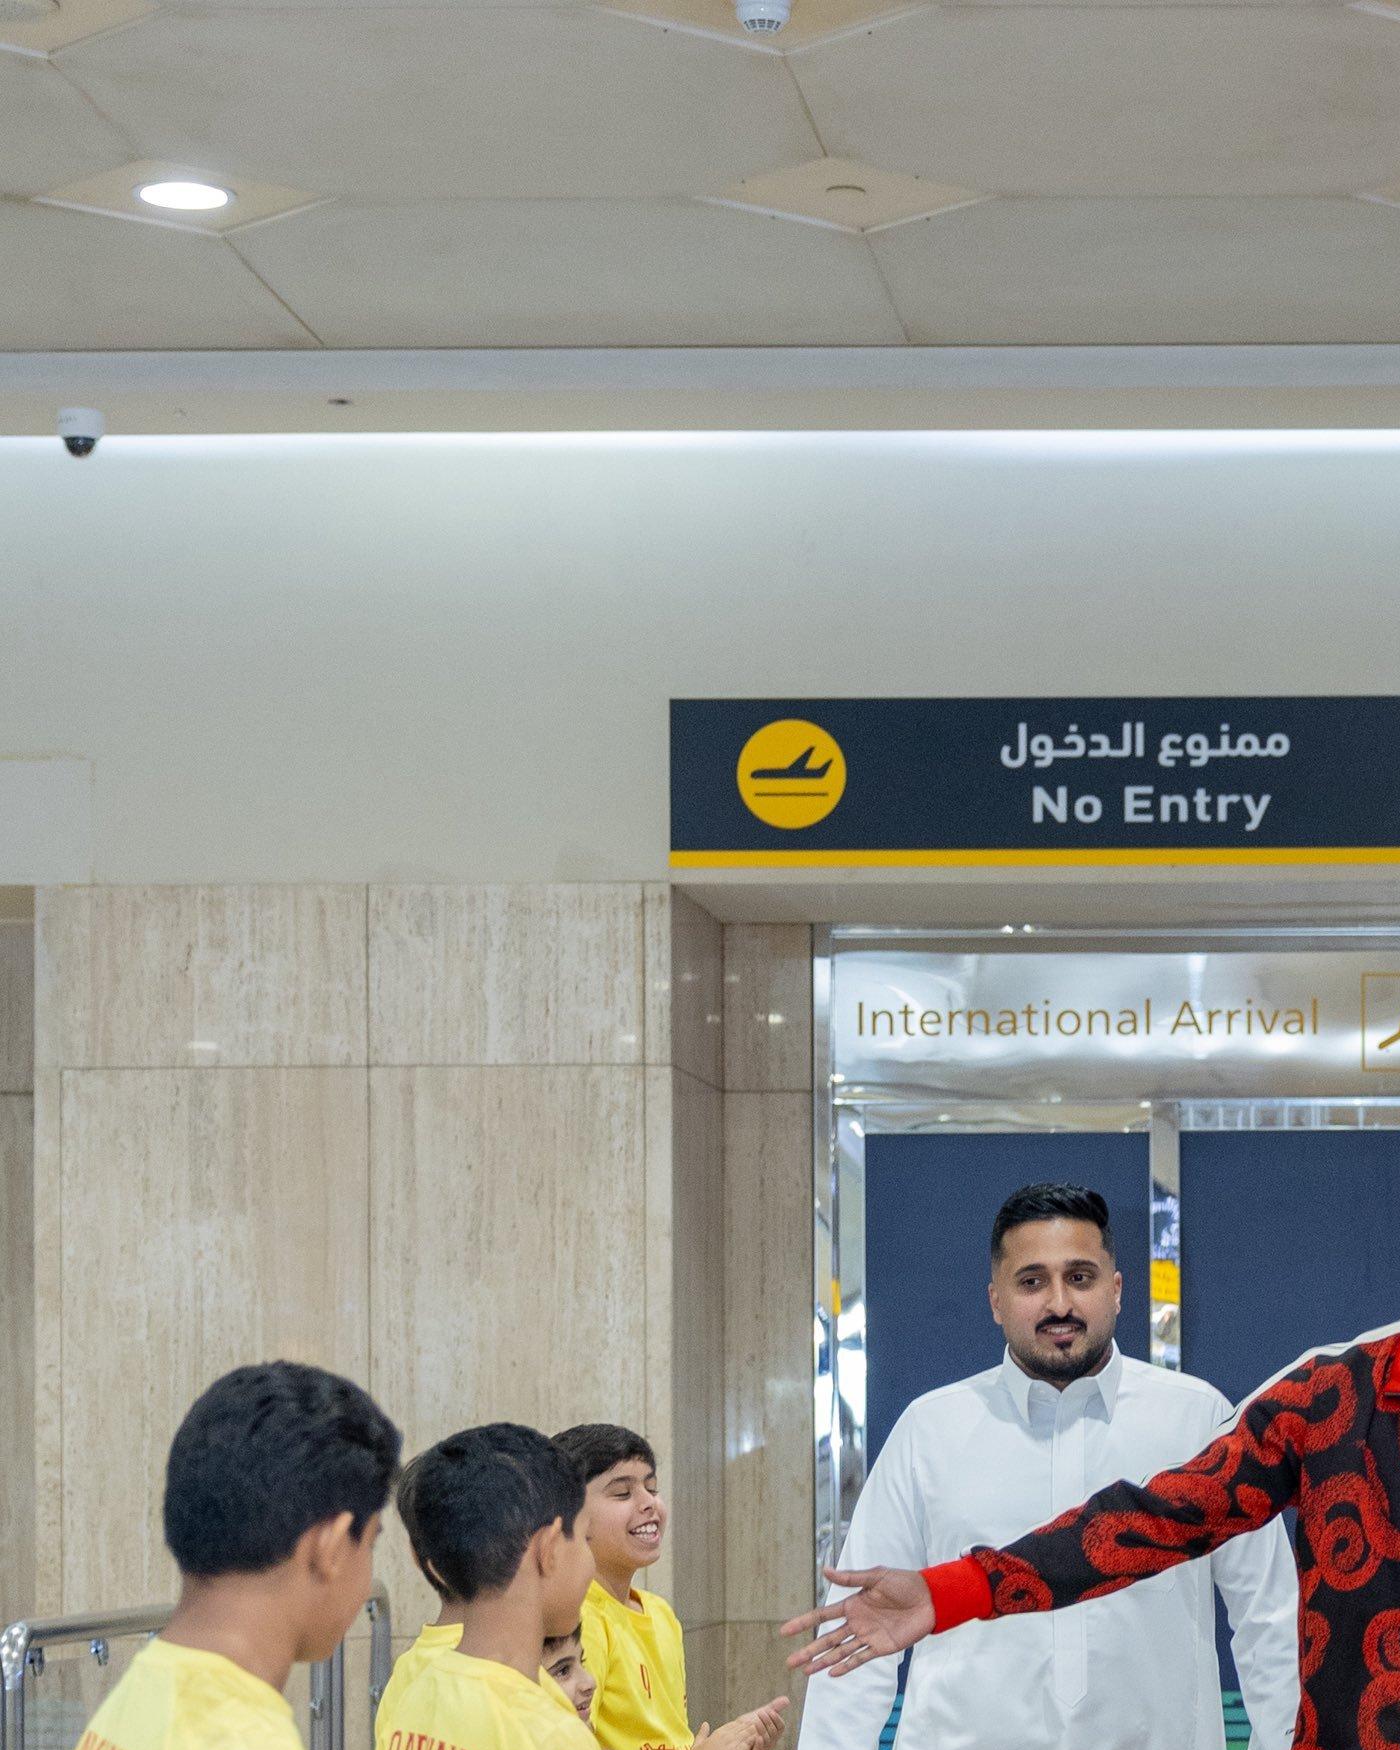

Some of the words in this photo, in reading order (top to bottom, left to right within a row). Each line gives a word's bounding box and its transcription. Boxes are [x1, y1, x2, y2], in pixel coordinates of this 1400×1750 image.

[1000, 721, 1145, 768] الدخول
[1157, 722, 1291, 767] ممنوع
[1032, 785, 1103, 824] No
[1123, 785, 1272, 832] Entry
[857, 997, 1152, 1036] International
[1171, 997, 1320, 1036] Arrival
